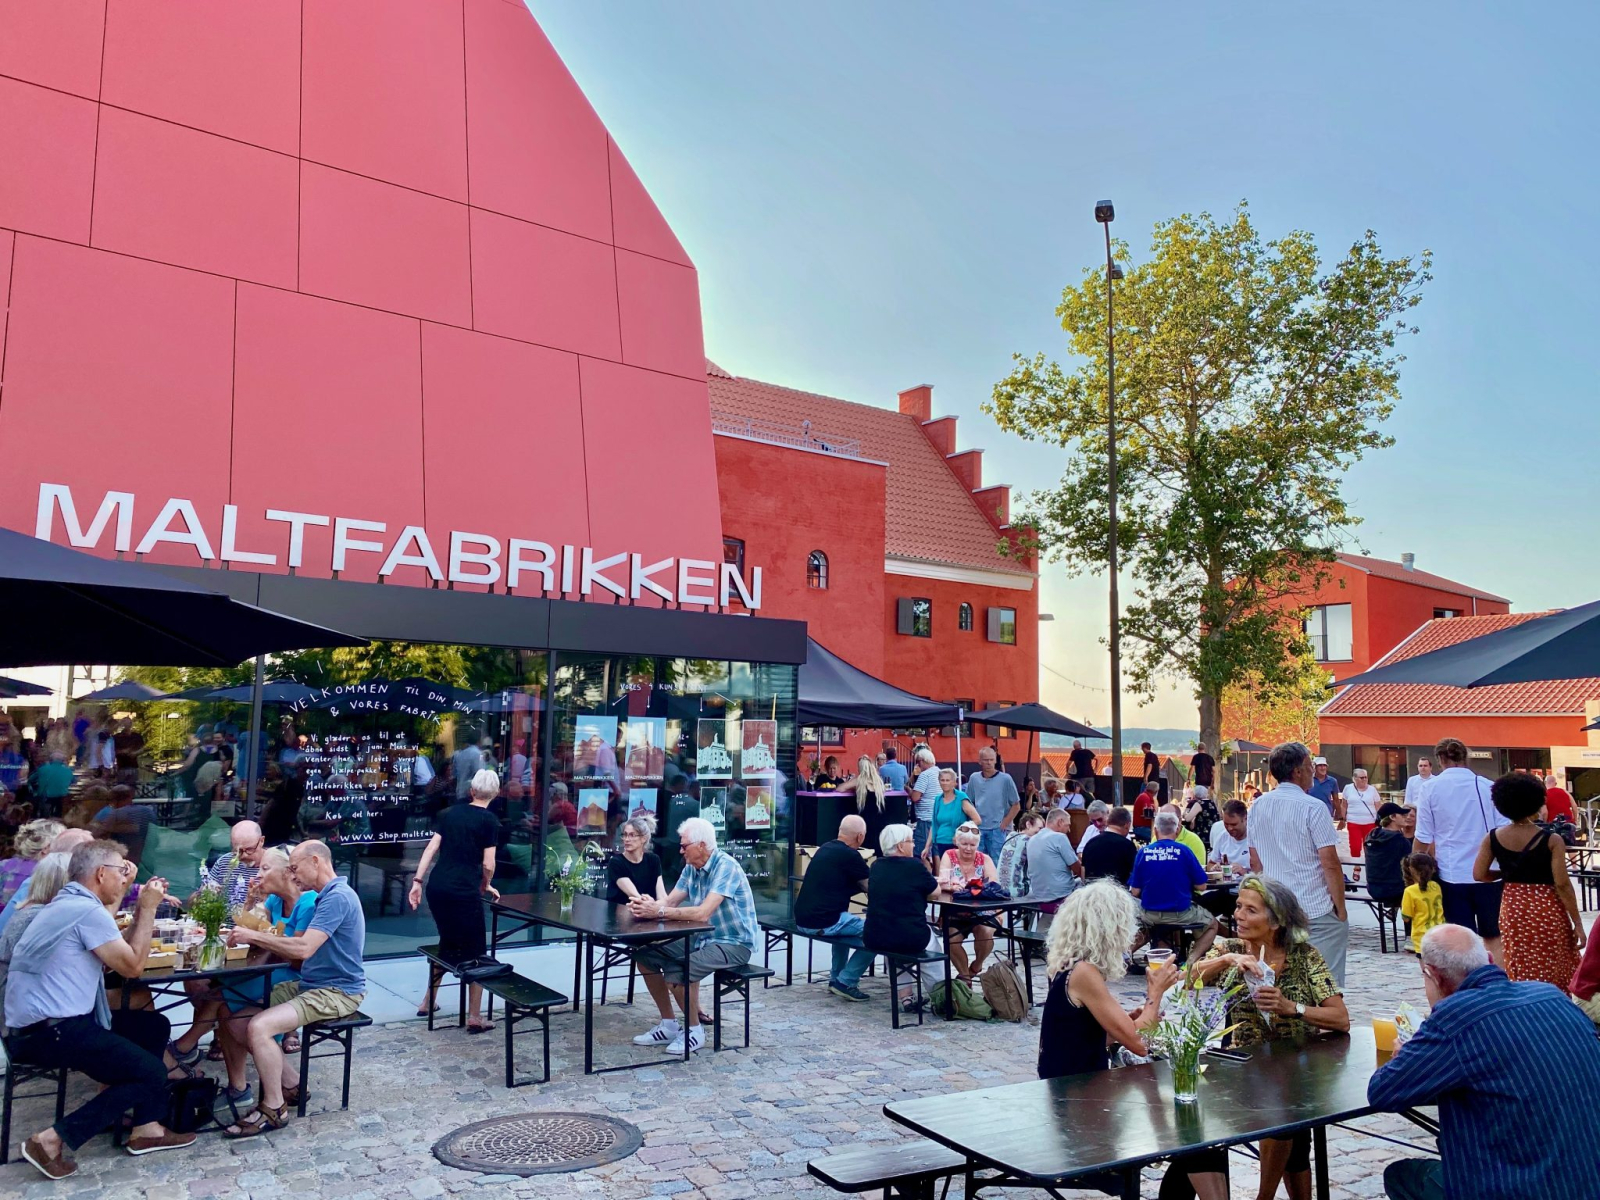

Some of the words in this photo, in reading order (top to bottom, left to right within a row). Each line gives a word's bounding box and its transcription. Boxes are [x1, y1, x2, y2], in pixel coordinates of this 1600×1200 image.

[35, 482, 762, 610] MALTFABRIKKEN
[289, 684, 389, 713] VELKOMMEN
[330, 706, 340, 717] &
[349, 699, 389, 711] VORES
[310, 733, 319, 743] Vi
[324, 734, 351, 745] glæder
[379, 731, 389, 740] til
[304, 744, 323, 753] åbne
[411, 742, 419, 751] vi
[357, 754, 364, 762] vi
[306, 767, 321, 776] egen
[305, 780, 363, 790] Maltfabrikken
[368, 783, 377, 791] og
[380, 779, 388, 788] få
[352, 811, 362, 819] det
